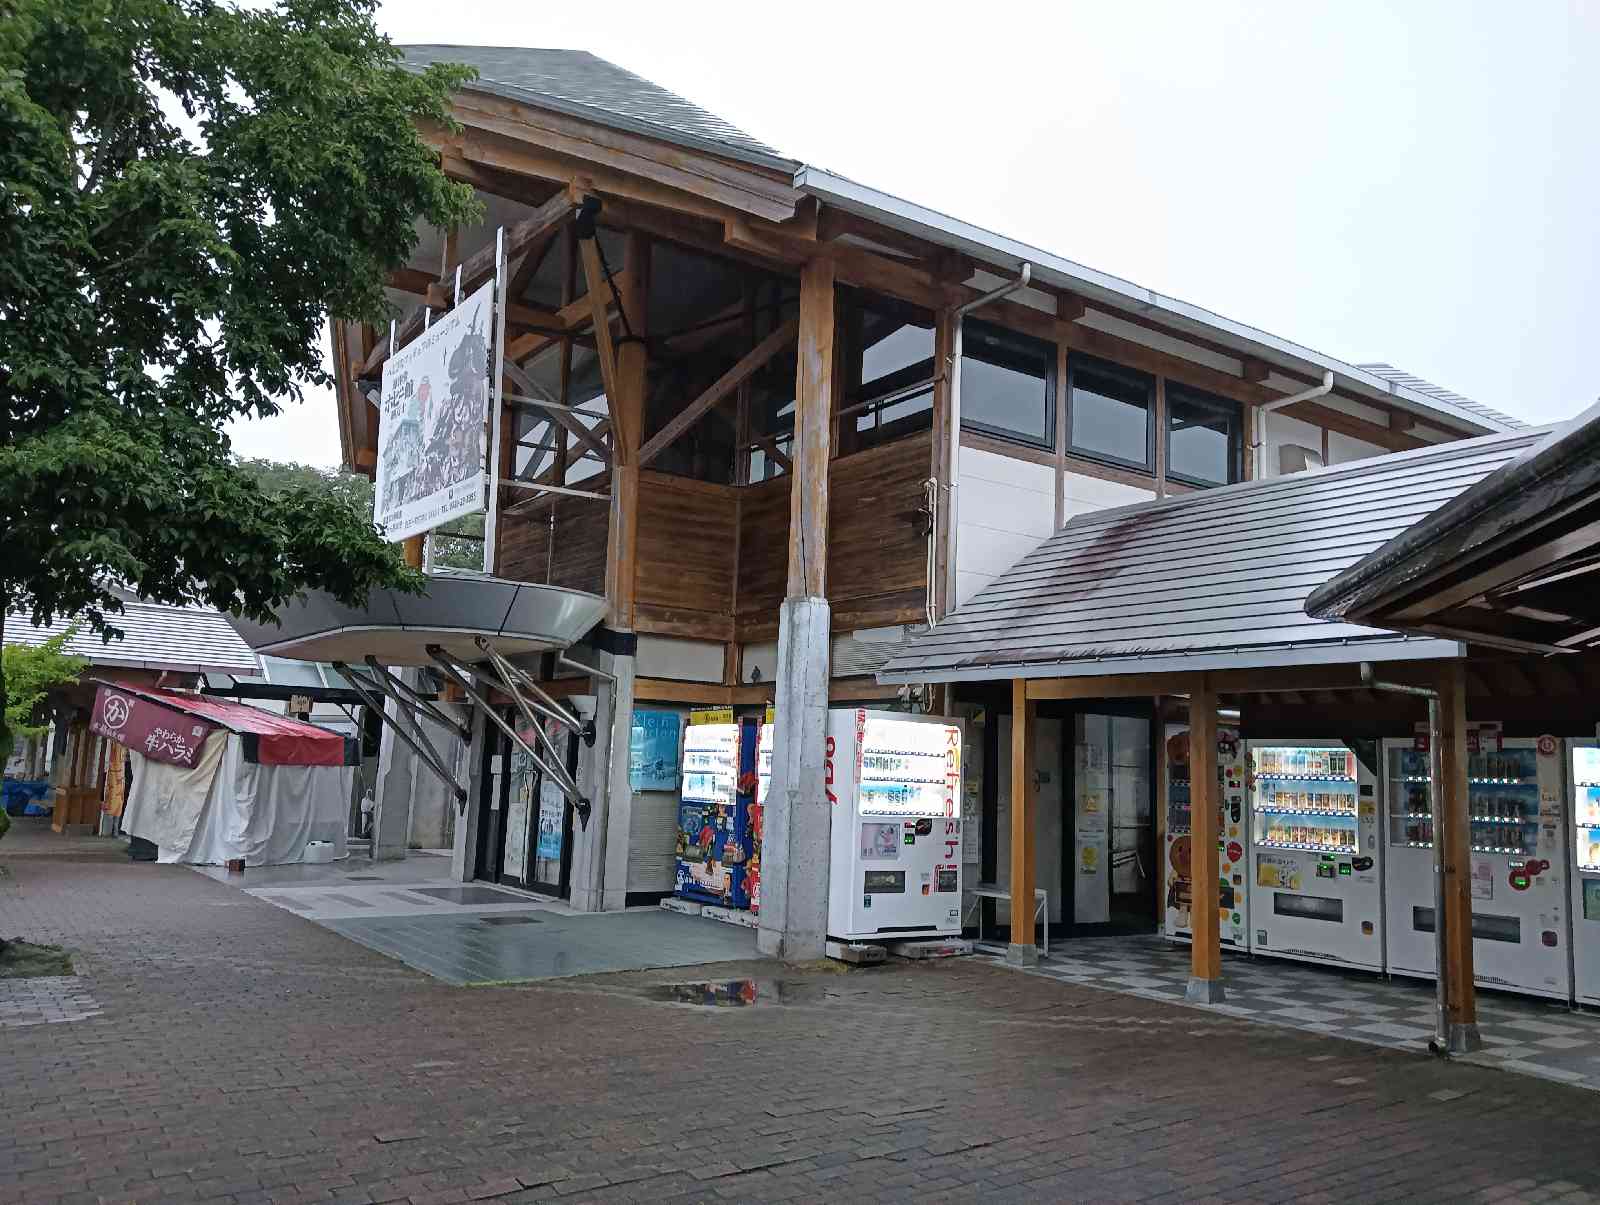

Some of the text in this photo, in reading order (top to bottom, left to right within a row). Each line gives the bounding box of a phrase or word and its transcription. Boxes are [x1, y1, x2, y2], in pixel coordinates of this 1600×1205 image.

[154, 727, 184, 743] やわらか
[144, 734, 194, 764] 牛ハラミ
